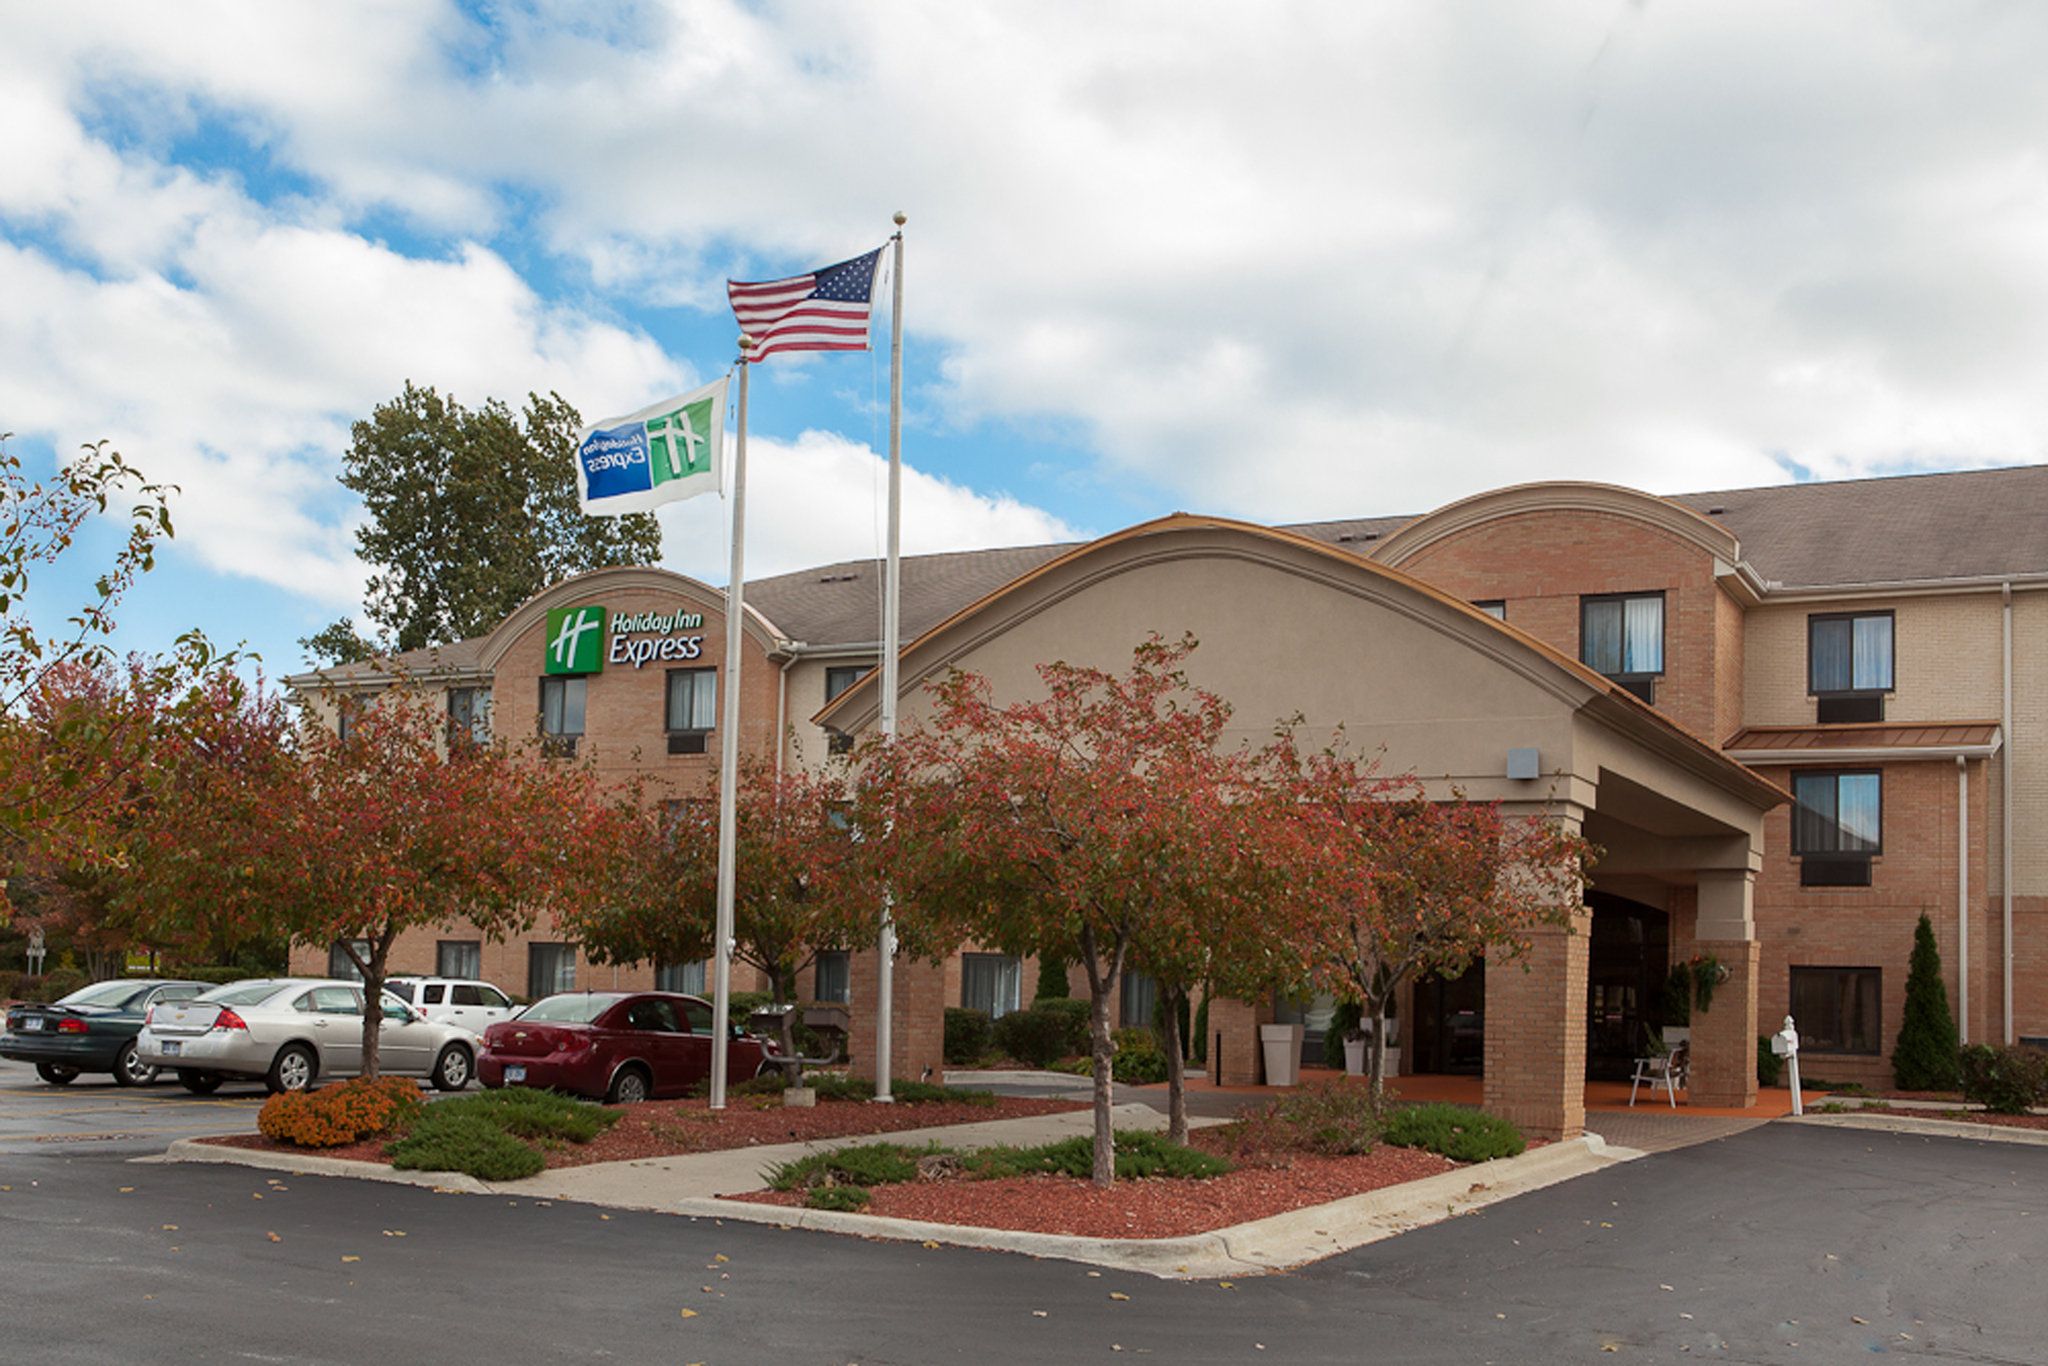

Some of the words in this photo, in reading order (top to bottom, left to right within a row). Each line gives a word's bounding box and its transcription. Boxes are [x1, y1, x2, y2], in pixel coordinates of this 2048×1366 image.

[610, 612, 674, 635] Holiday
[674, 608, 702, 629] Inn
[609, 634, 702, 669] Express
